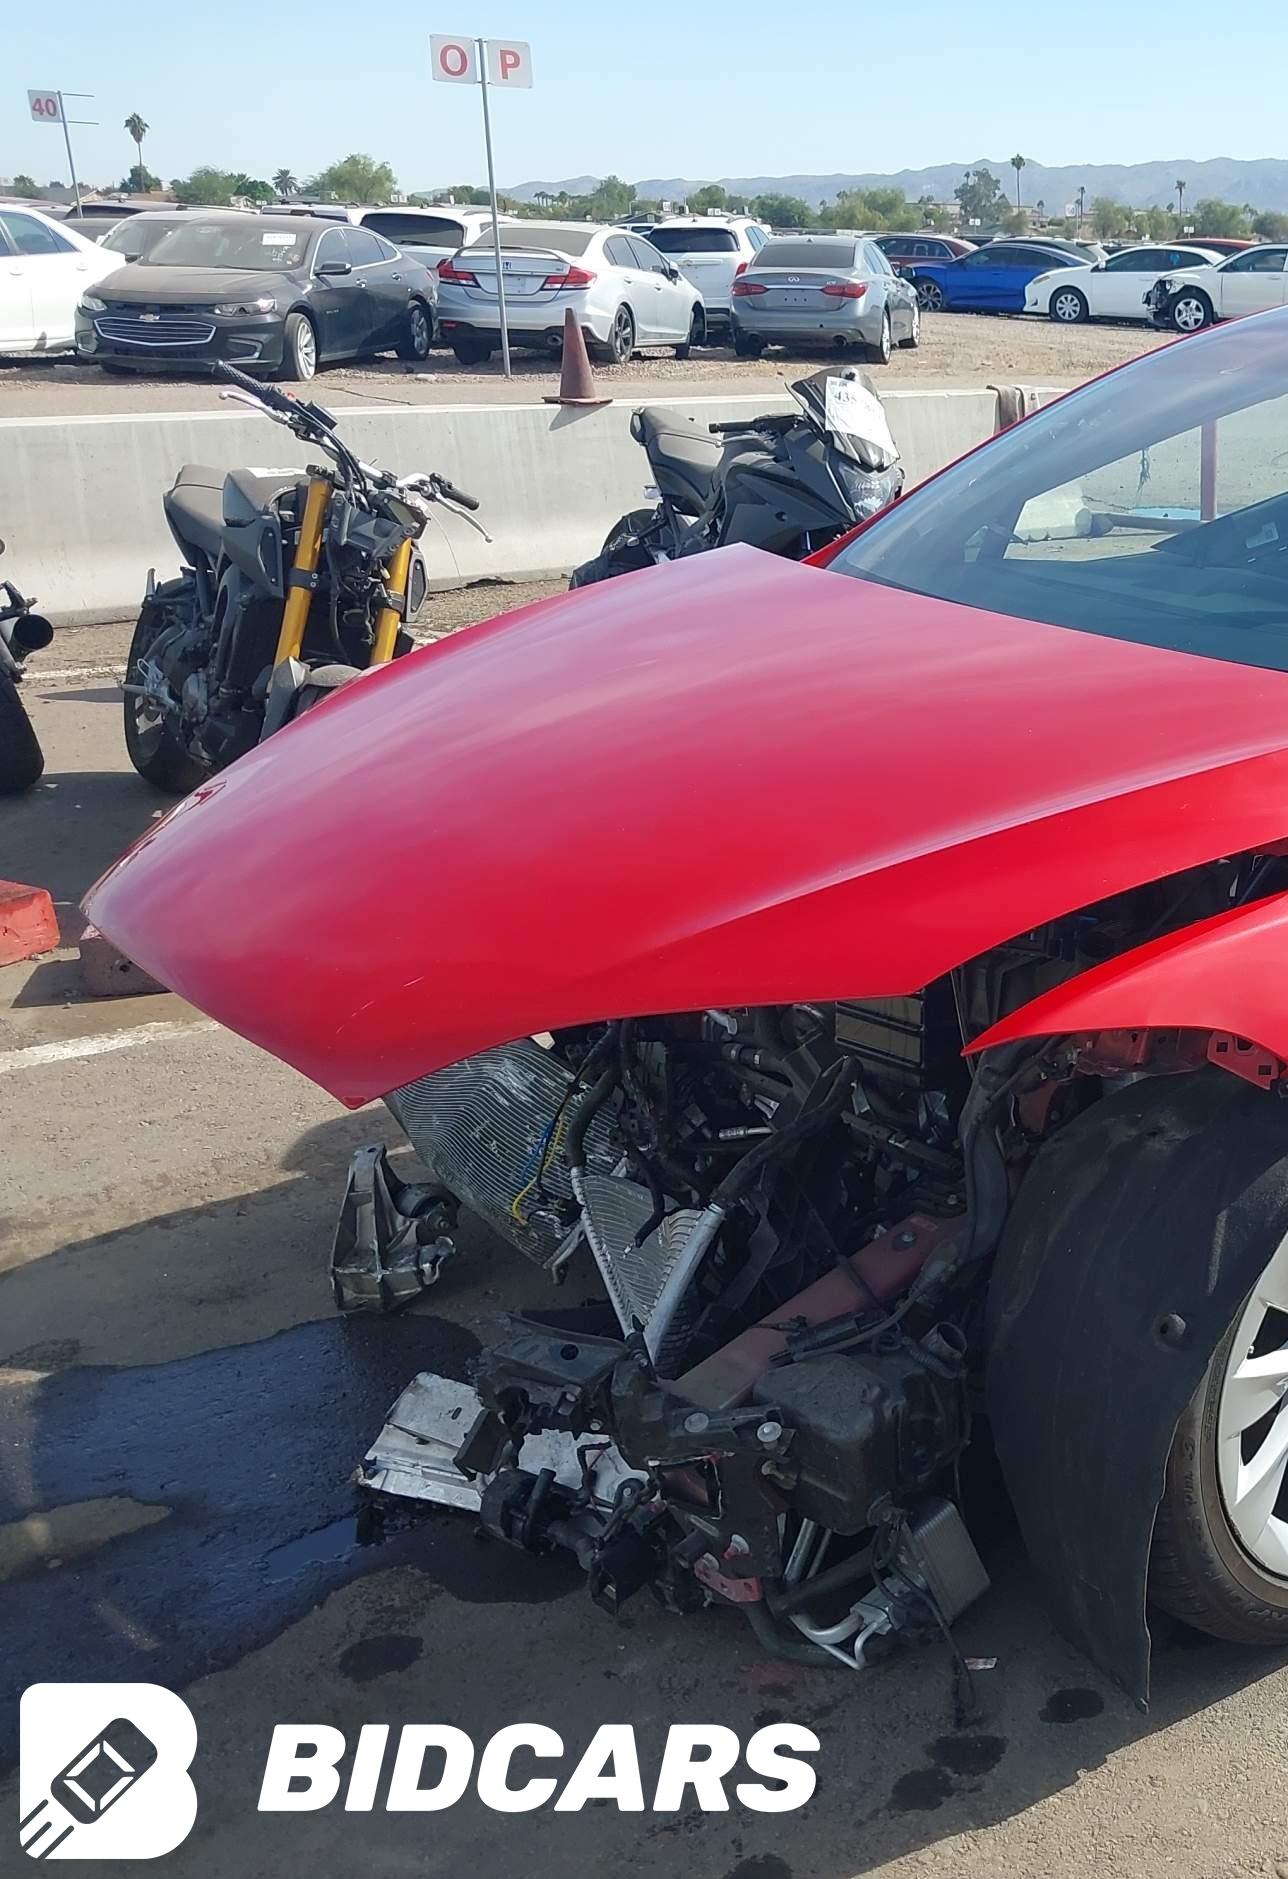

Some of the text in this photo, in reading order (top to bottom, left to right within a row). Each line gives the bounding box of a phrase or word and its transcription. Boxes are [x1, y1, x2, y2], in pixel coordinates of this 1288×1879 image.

[440, 44, 467, 76] O
[500, 49, 520, 79] P
[33, 98, 57, 116] 40
